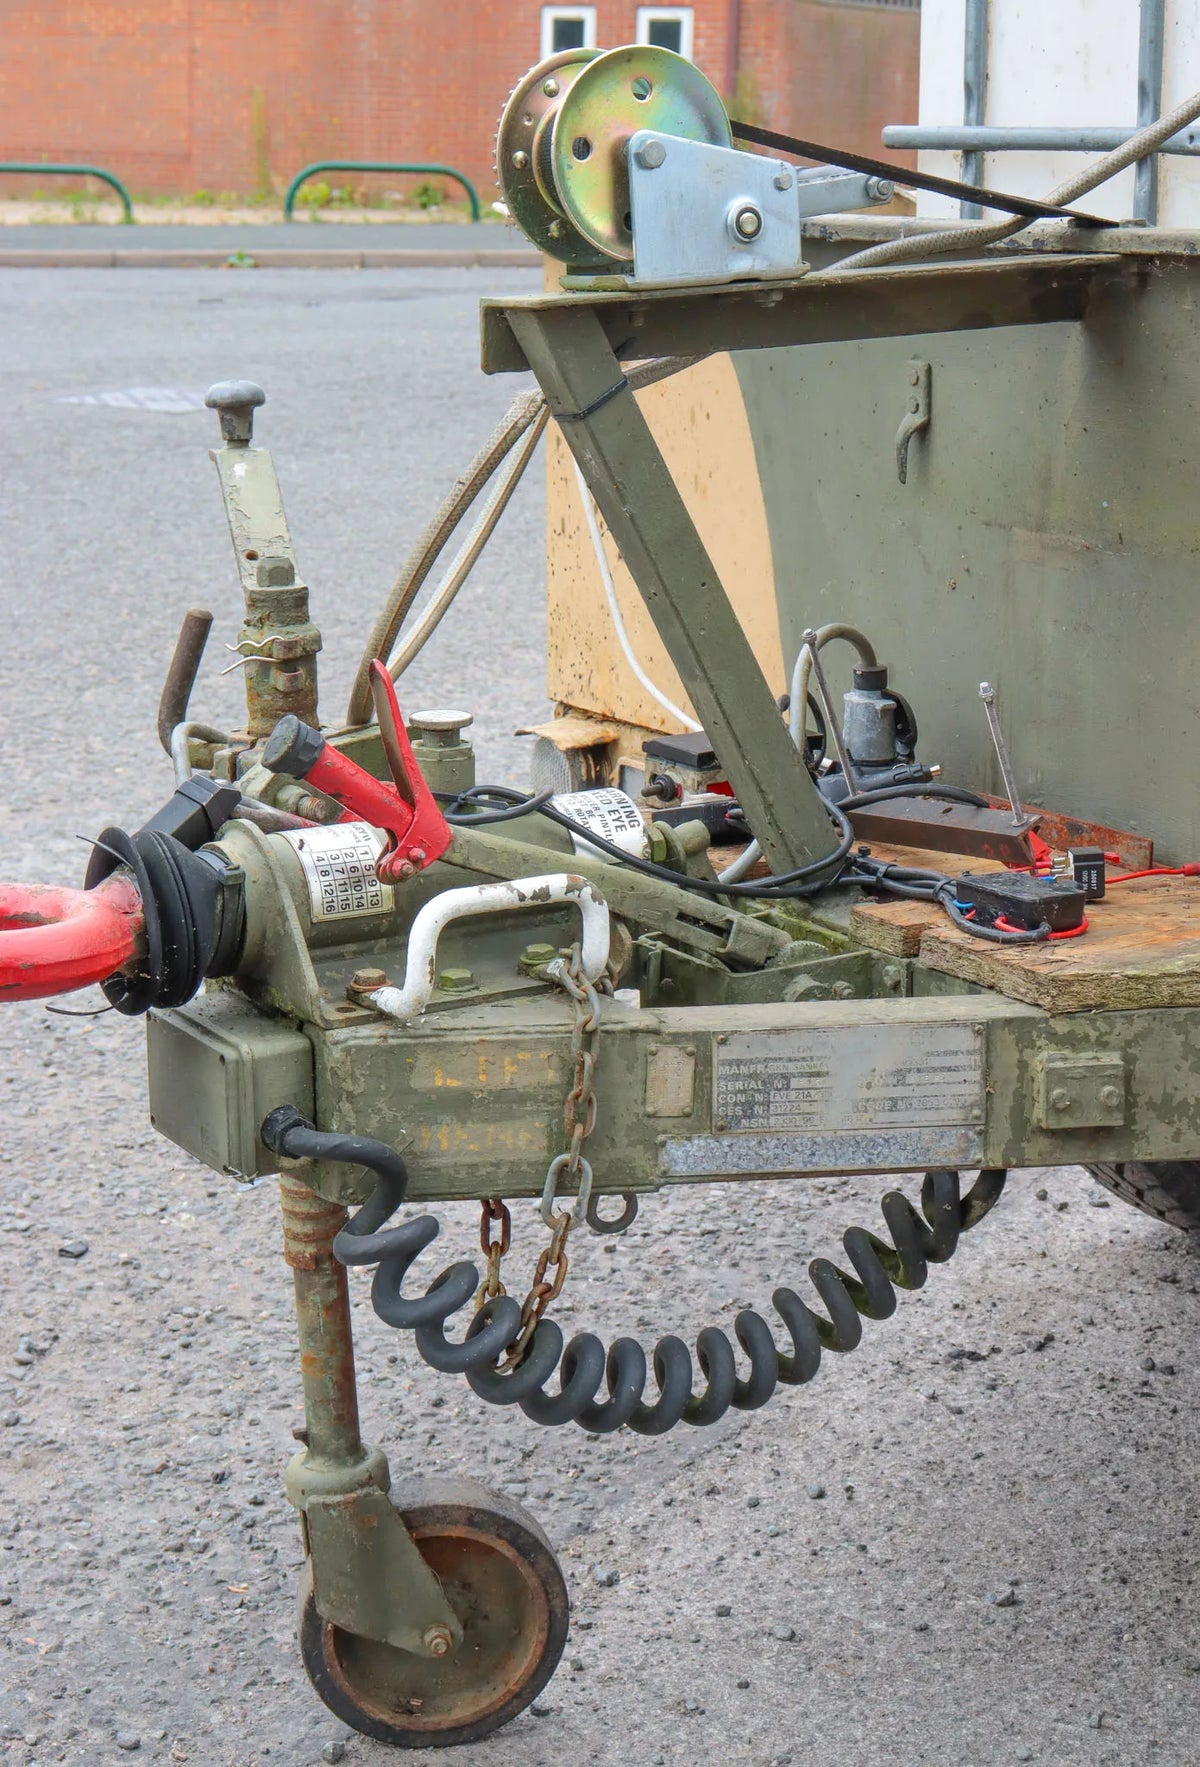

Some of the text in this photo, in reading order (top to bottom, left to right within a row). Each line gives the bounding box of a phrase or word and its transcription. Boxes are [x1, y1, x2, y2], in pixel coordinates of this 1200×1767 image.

[585, 809, 597, 819] BE
[604, 788, 641, 829] ARNING
[607, 808, 628, 833] EYE
[596, 813, 615, 843] PINTLE
[343, 851, 355, 859] 2
[334, 867, 345, 875] 7
[349, 865, 360, 873] 6
[315, 855, 336, 913] 4 8 12 16
[338, 881, 349, 893] 11
[352, 878, 363, 892] 10
[367, 879, 378, 888] 9
[340, 897, 351, 911] 15
[355, 894, 365, 909] 14
[369, 893, 380, 907] 13
[719, 1064, 766, 1076] MANFR
[718, 1080, 764, 1092] SERIAL
[718, 1093, 746, 1104] CON
[795, 1090, 812, 1100] 21A
[718, 1106, 743, 1117] CES
[740, 1118, 769, 1129] NSN
